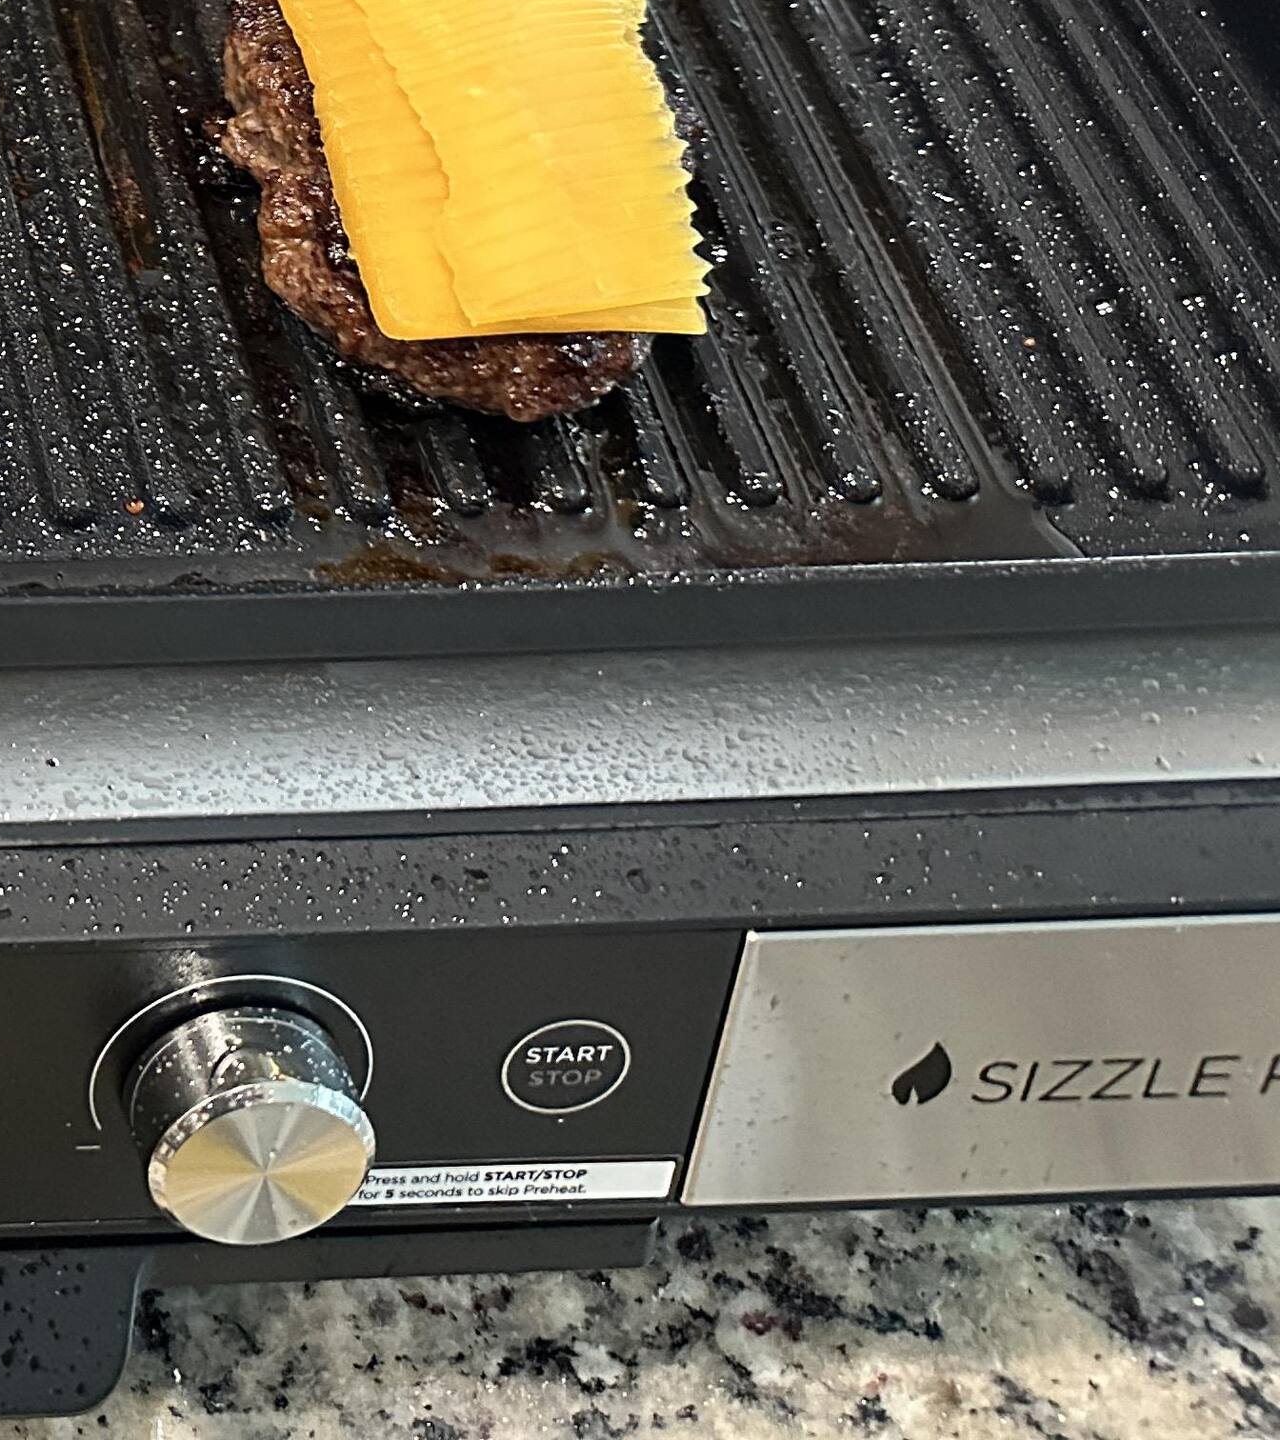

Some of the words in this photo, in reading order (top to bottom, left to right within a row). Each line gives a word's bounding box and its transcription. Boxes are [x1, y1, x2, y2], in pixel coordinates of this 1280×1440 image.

[525, 1045, 614, 1065] START
[529, 1069, 603, 1088] STOP
[971, 1055, 1243, 1103] SIZZLE
[364, 1175, 407, 1184] Press
[410, 1172, 440, 1184] and
[445, 1171, 480, 1183] hold
[483, 1168, 588, 1182] START/STOP
[358, 1189, 379, 1200] for
[385, 1190, 394, 1199] 5
[399, 1187, 463, 1198] seconds
[467, 1186, 484, 1197] to
[488, 1183, 519, 1198] skip
[523, 1182, 588, 1195] Preheat.
